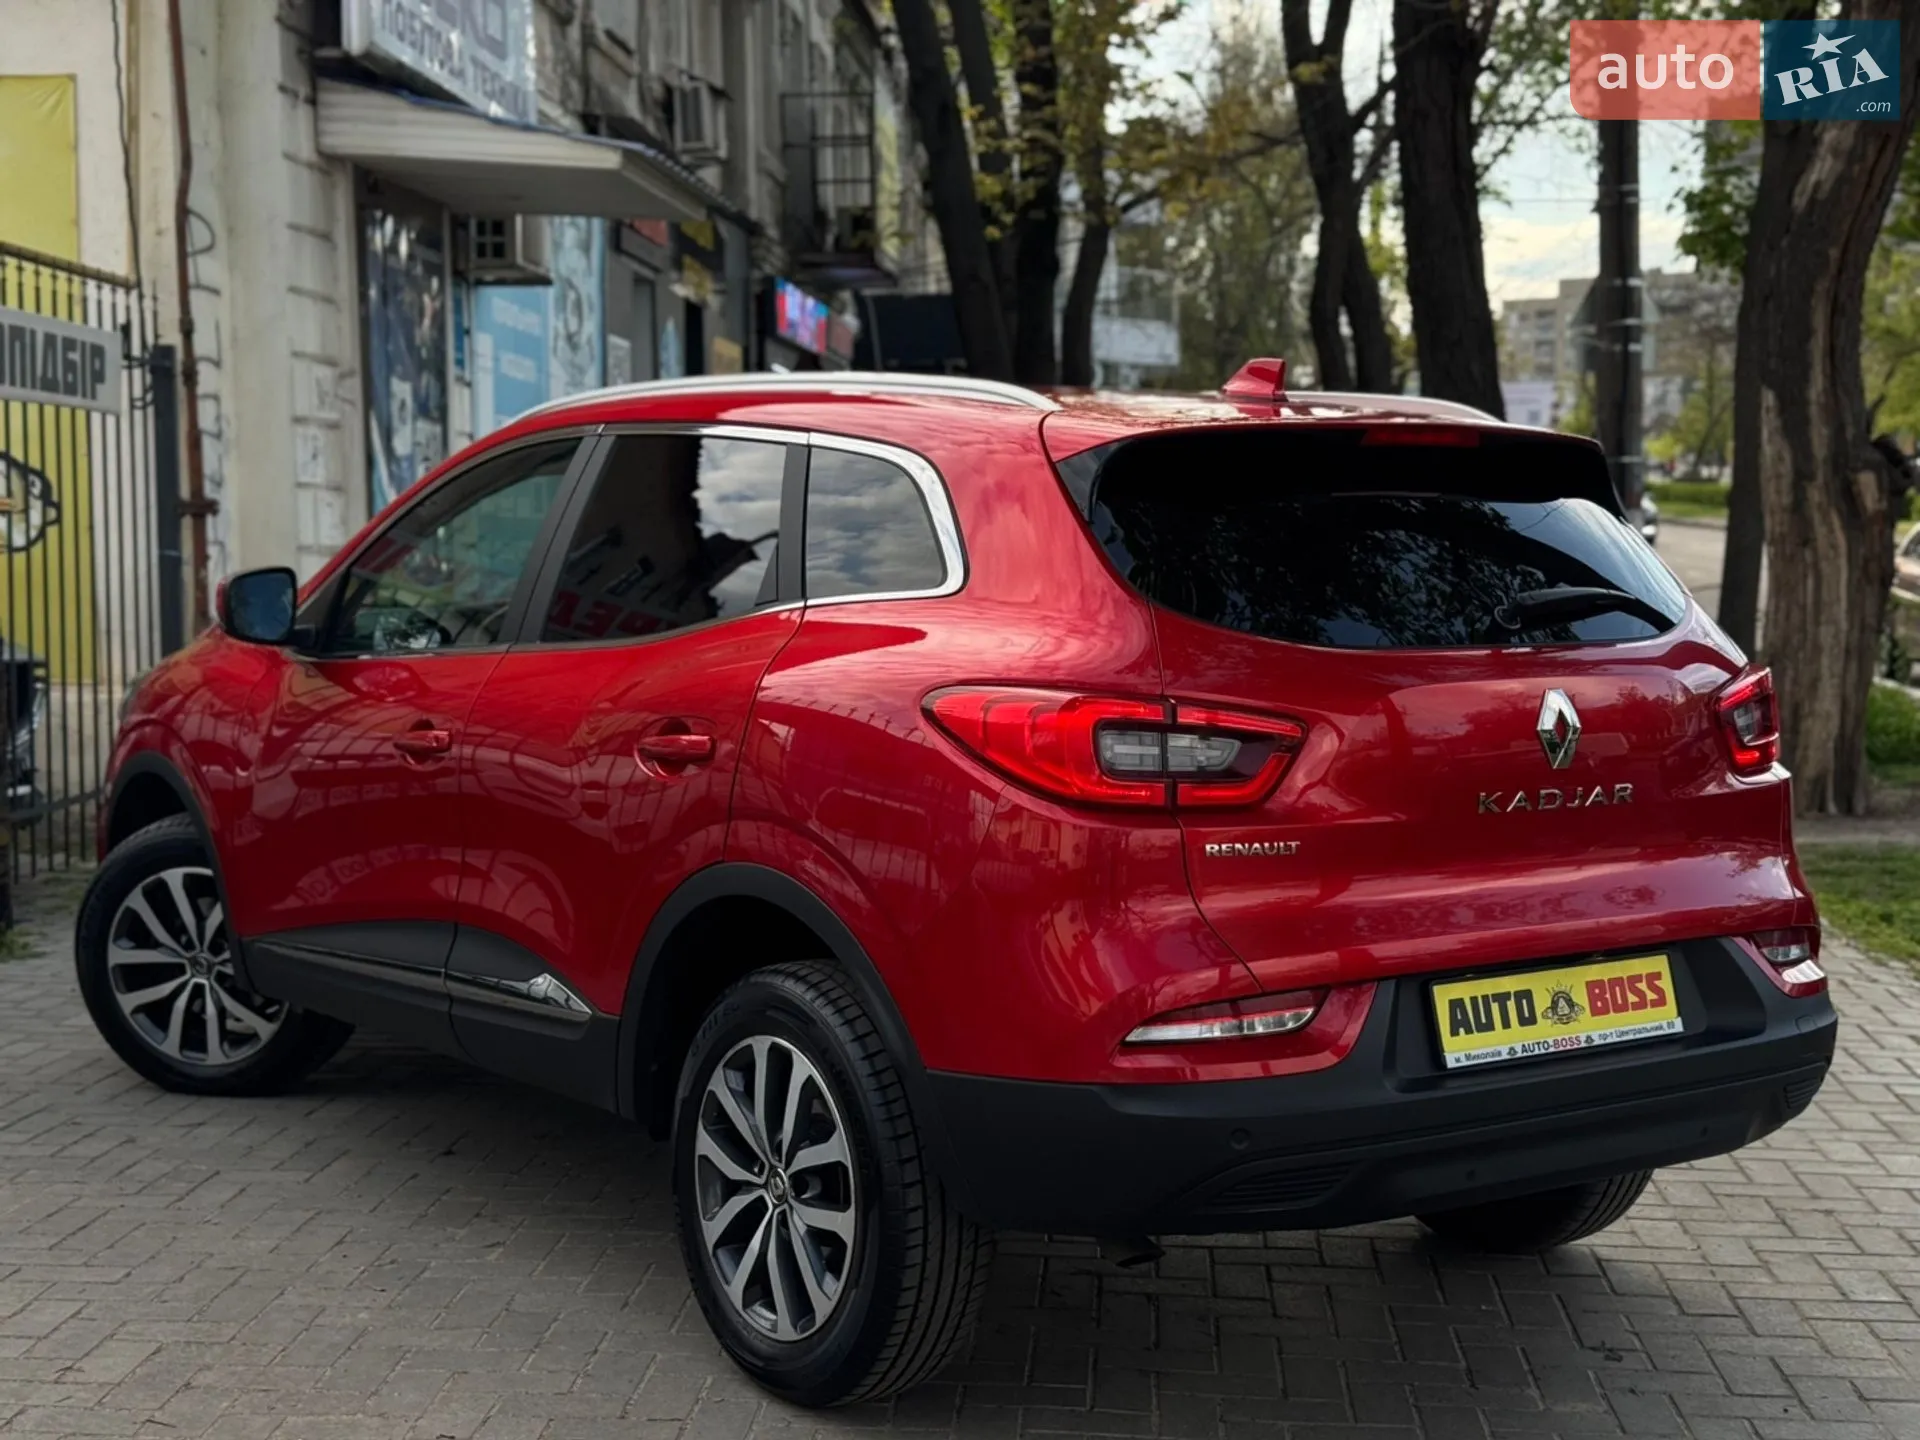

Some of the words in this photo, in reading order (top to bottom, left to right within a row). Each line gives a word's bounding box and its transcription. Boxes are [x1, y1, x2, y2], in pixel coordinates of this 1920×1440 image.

[1478, 783, 1634, 815] KADJAR
[1205, 841, 1300, 857] RENAULT
[1448, 989, 1538, 1037] AUTO
[1585, 972, 1668, 1018] BOSS
[1521, 1035, 1582, 1055] AUTO-BOSS
